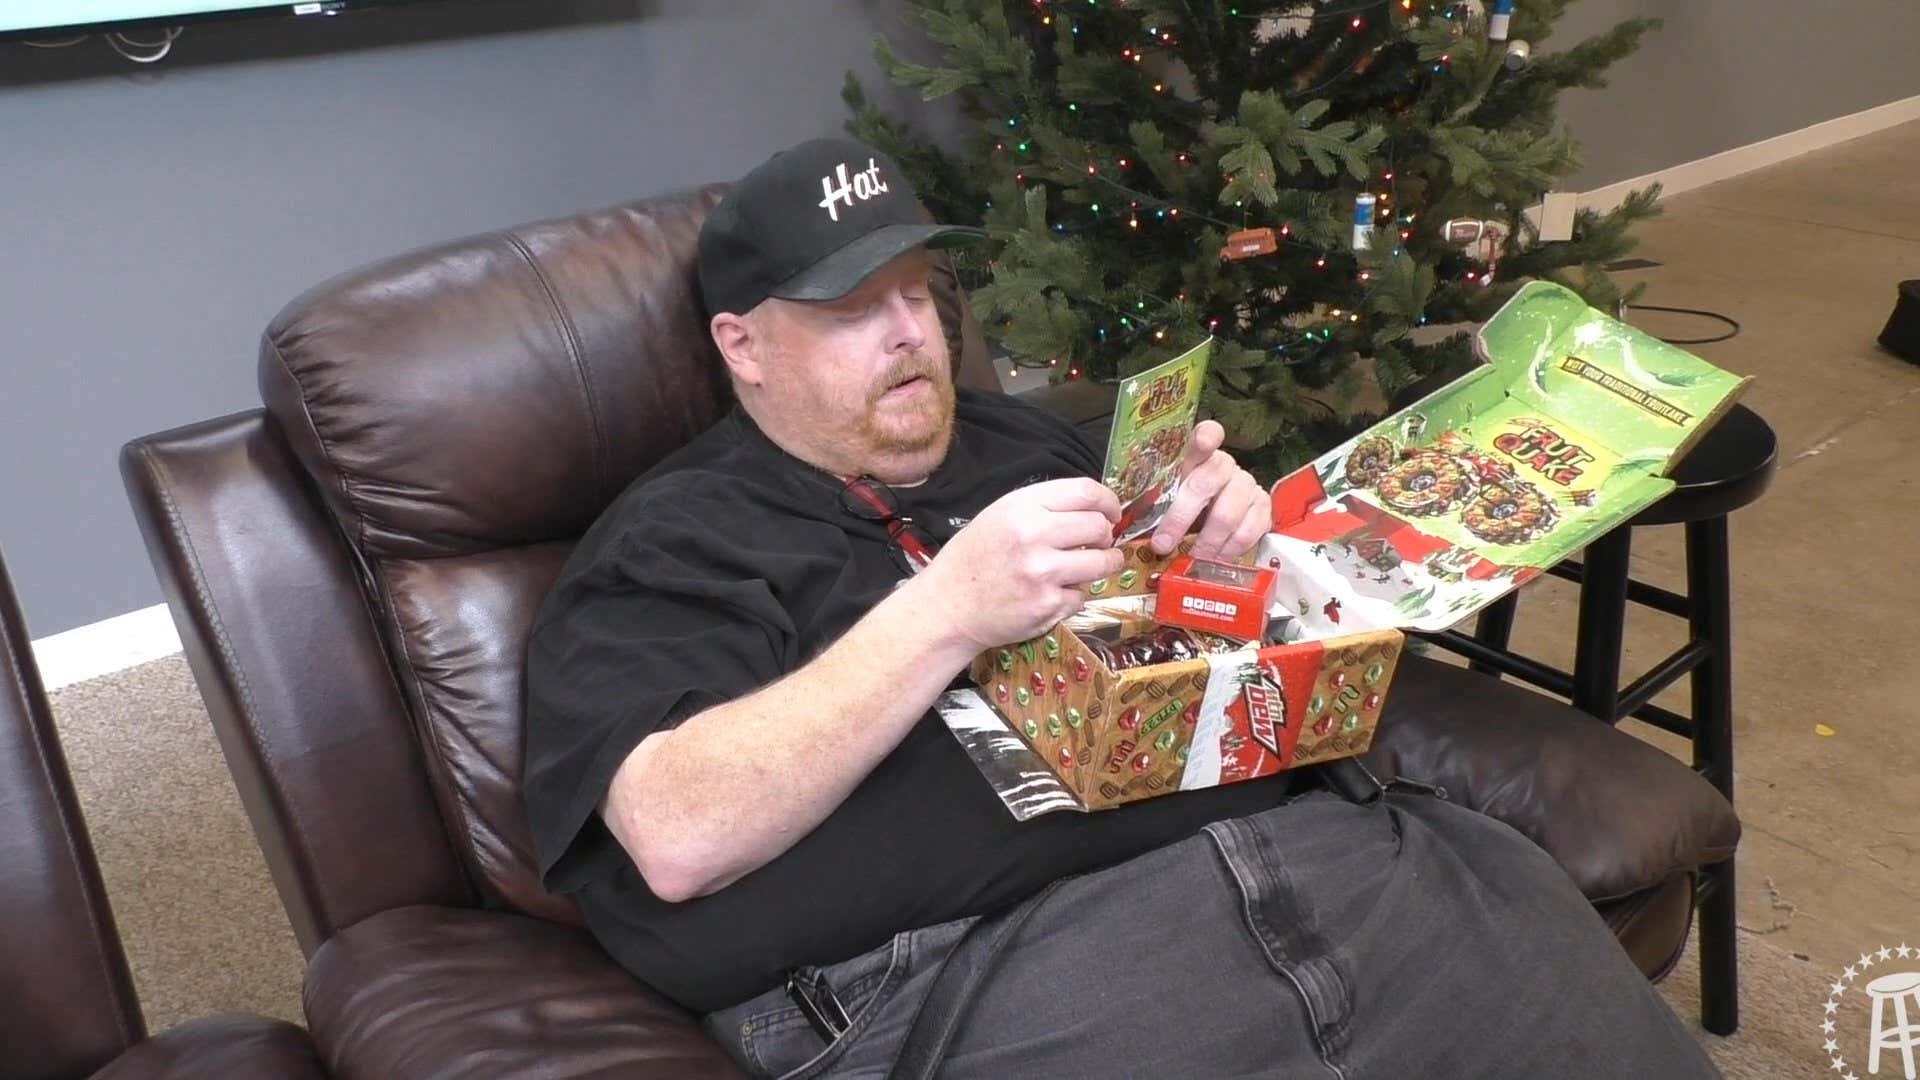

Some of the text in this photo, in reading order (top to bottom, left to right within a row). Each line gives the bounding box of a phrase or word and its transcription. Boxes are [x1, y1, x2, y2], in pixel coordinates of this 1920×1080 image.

[819, 158, 888, 221] Hat
[1565, 358, 1583, 373] NOT
[1582, 364, 1603, 381] YOUR
[1600, 373, 1645, 403] TRADITIONAL
[1493, 433, 1584, 486] QUAKE
[1519, 426, 1595, 466] FRUIT
